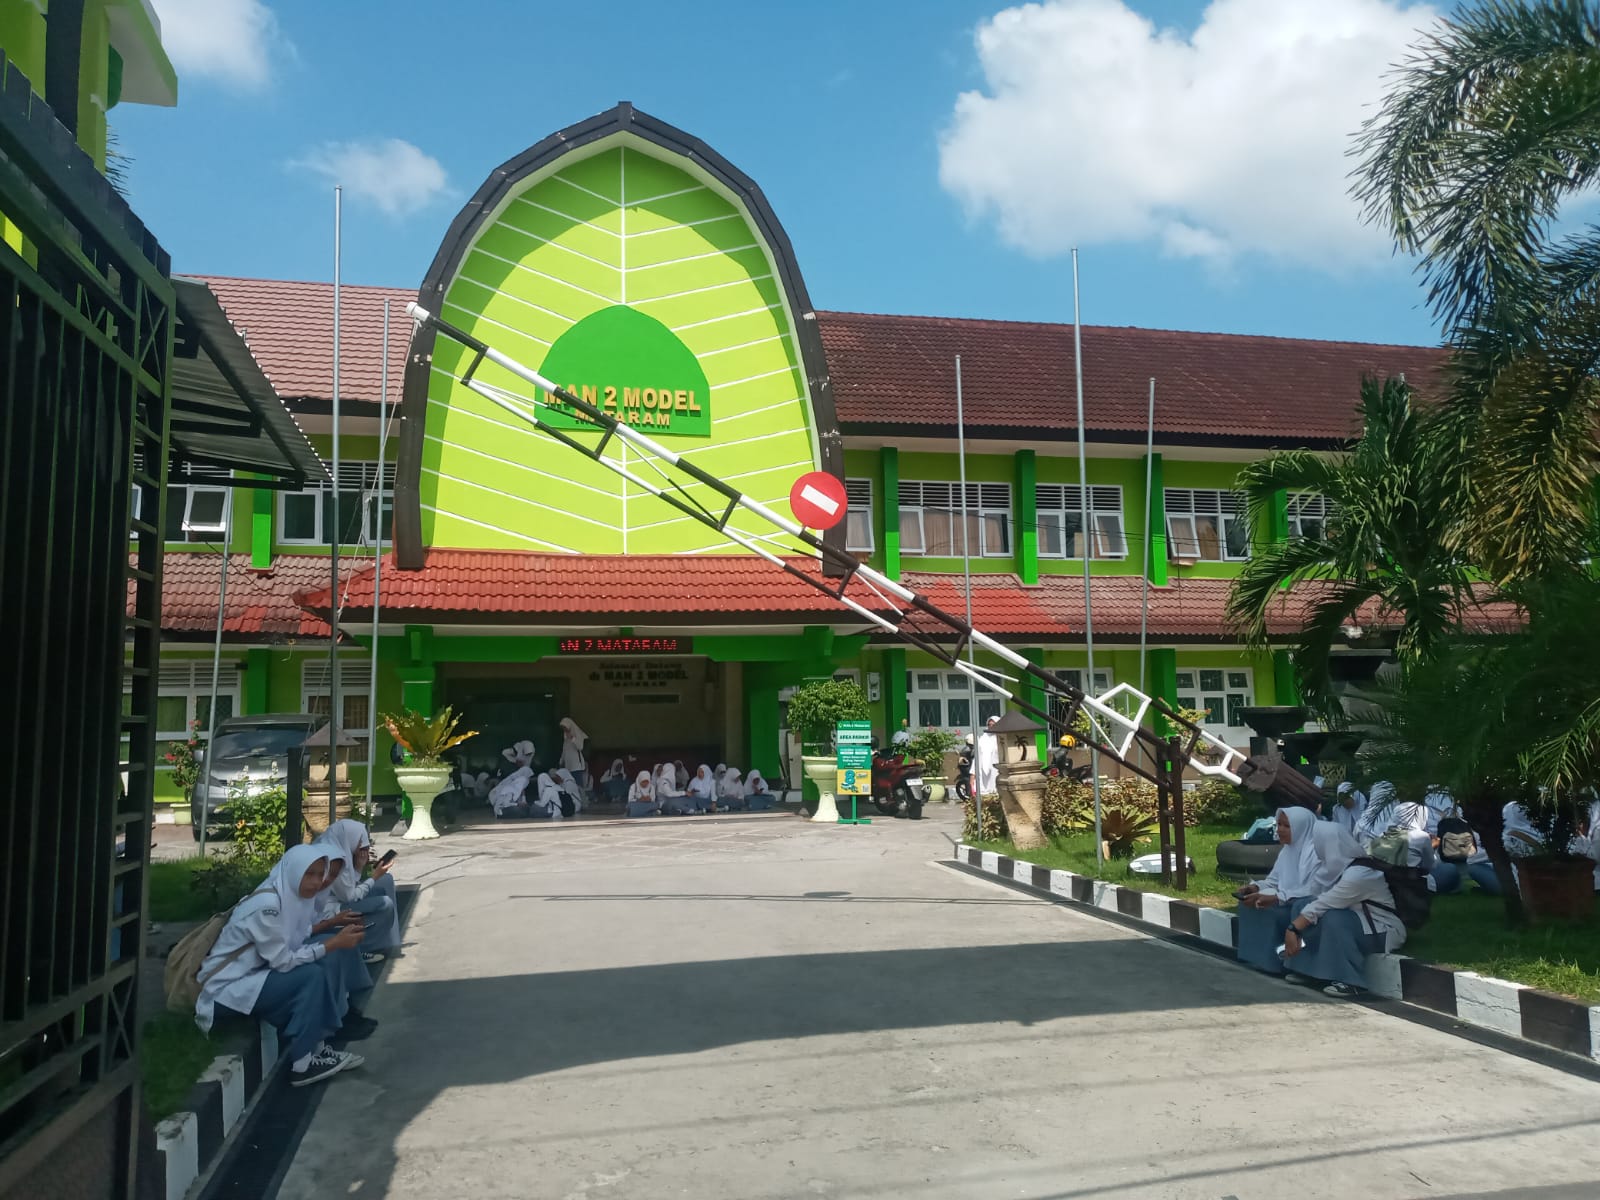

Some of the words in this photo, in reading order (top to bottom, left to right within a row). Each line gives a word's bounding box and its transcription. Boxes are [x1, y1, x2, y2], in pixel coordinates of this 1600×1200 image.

[603, 386, 618, 407] 2
[623, 387, 701, 411] MODEL
[604, 671, 633, 681] MAN
[647, 671, 689, 681] MODEL
